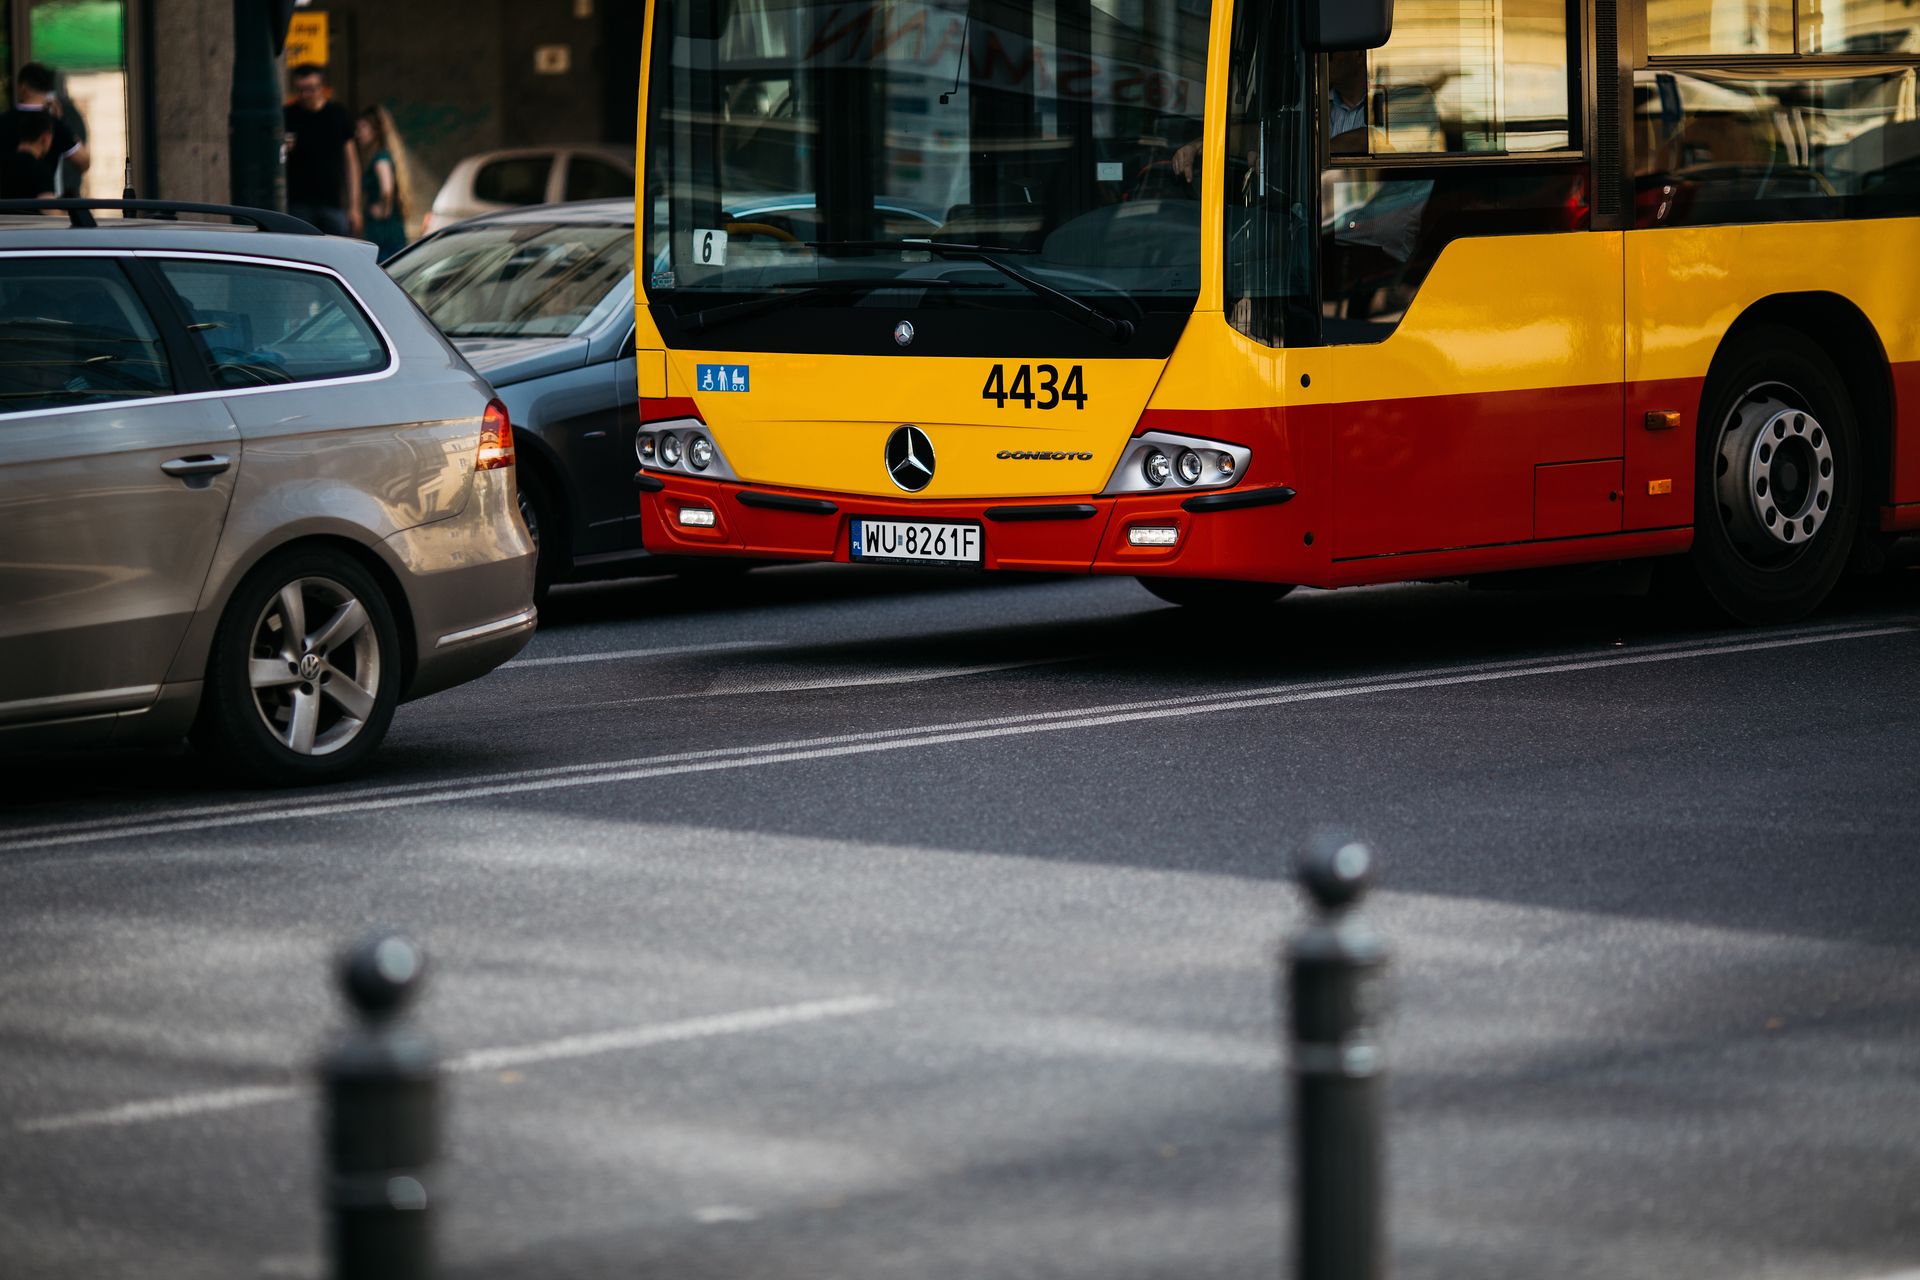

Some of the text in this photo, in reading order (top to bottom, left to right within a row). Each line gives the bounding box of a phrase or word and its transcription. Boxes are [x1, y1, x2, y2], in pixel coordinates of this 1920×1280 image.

[703, 232, 712, 263] 6
[983, 364, 1088, 410] 4434
[853, 541, 861, 549] PL
[866, 524, 976, 557] WU 8261F
